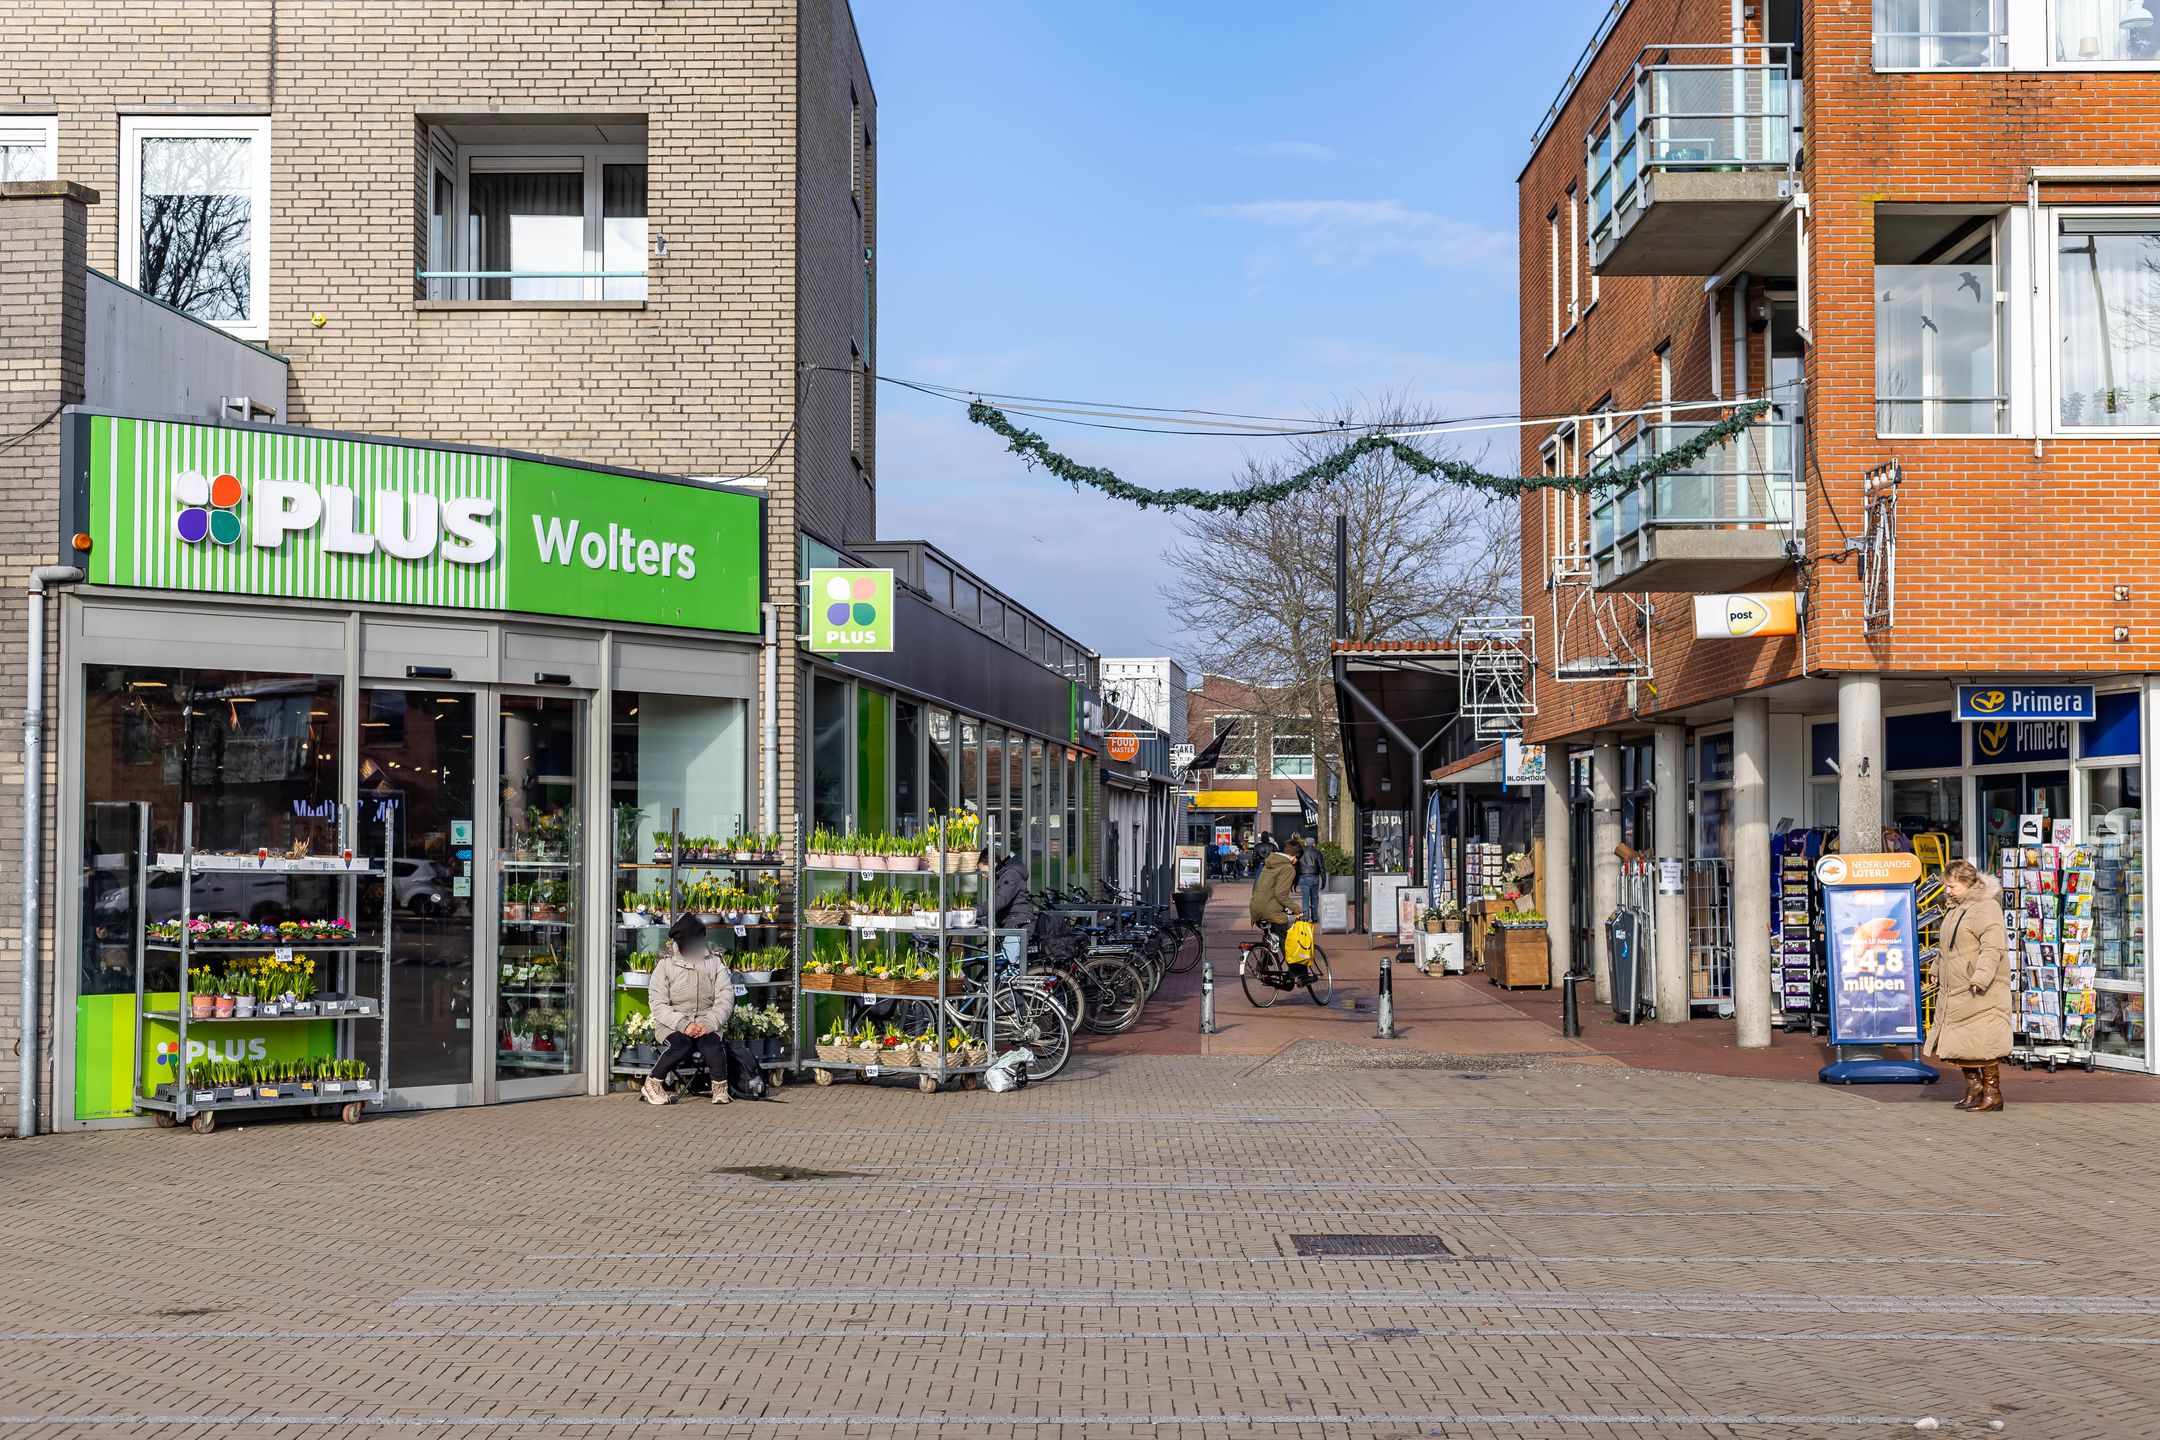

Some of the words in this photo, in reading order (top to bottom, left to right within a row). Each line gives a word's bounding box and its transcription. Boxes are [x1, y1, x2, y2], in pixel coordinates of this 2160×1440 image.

[252, 478, 498, 565] PLUS
[531, 514, 697, 581] Wolters
[1730, 611, 1753, 622] post
[826, 630, 877, 645] PLUS
[2012, 690, 2083, 712] Primera
[1111, 738, 1135, 747] FOOD
[2016, 720, 2068, 752] Primera
[1851, 859, 1912, 869] NEDERLANDSE
[1851, 869, 1889, 878] LOTERIJ
[1842, 948, 1904, 976] 14,8
[1843, 976, 1905, 994] miljoen
[185, 1037, 267, 1064] PLUS
